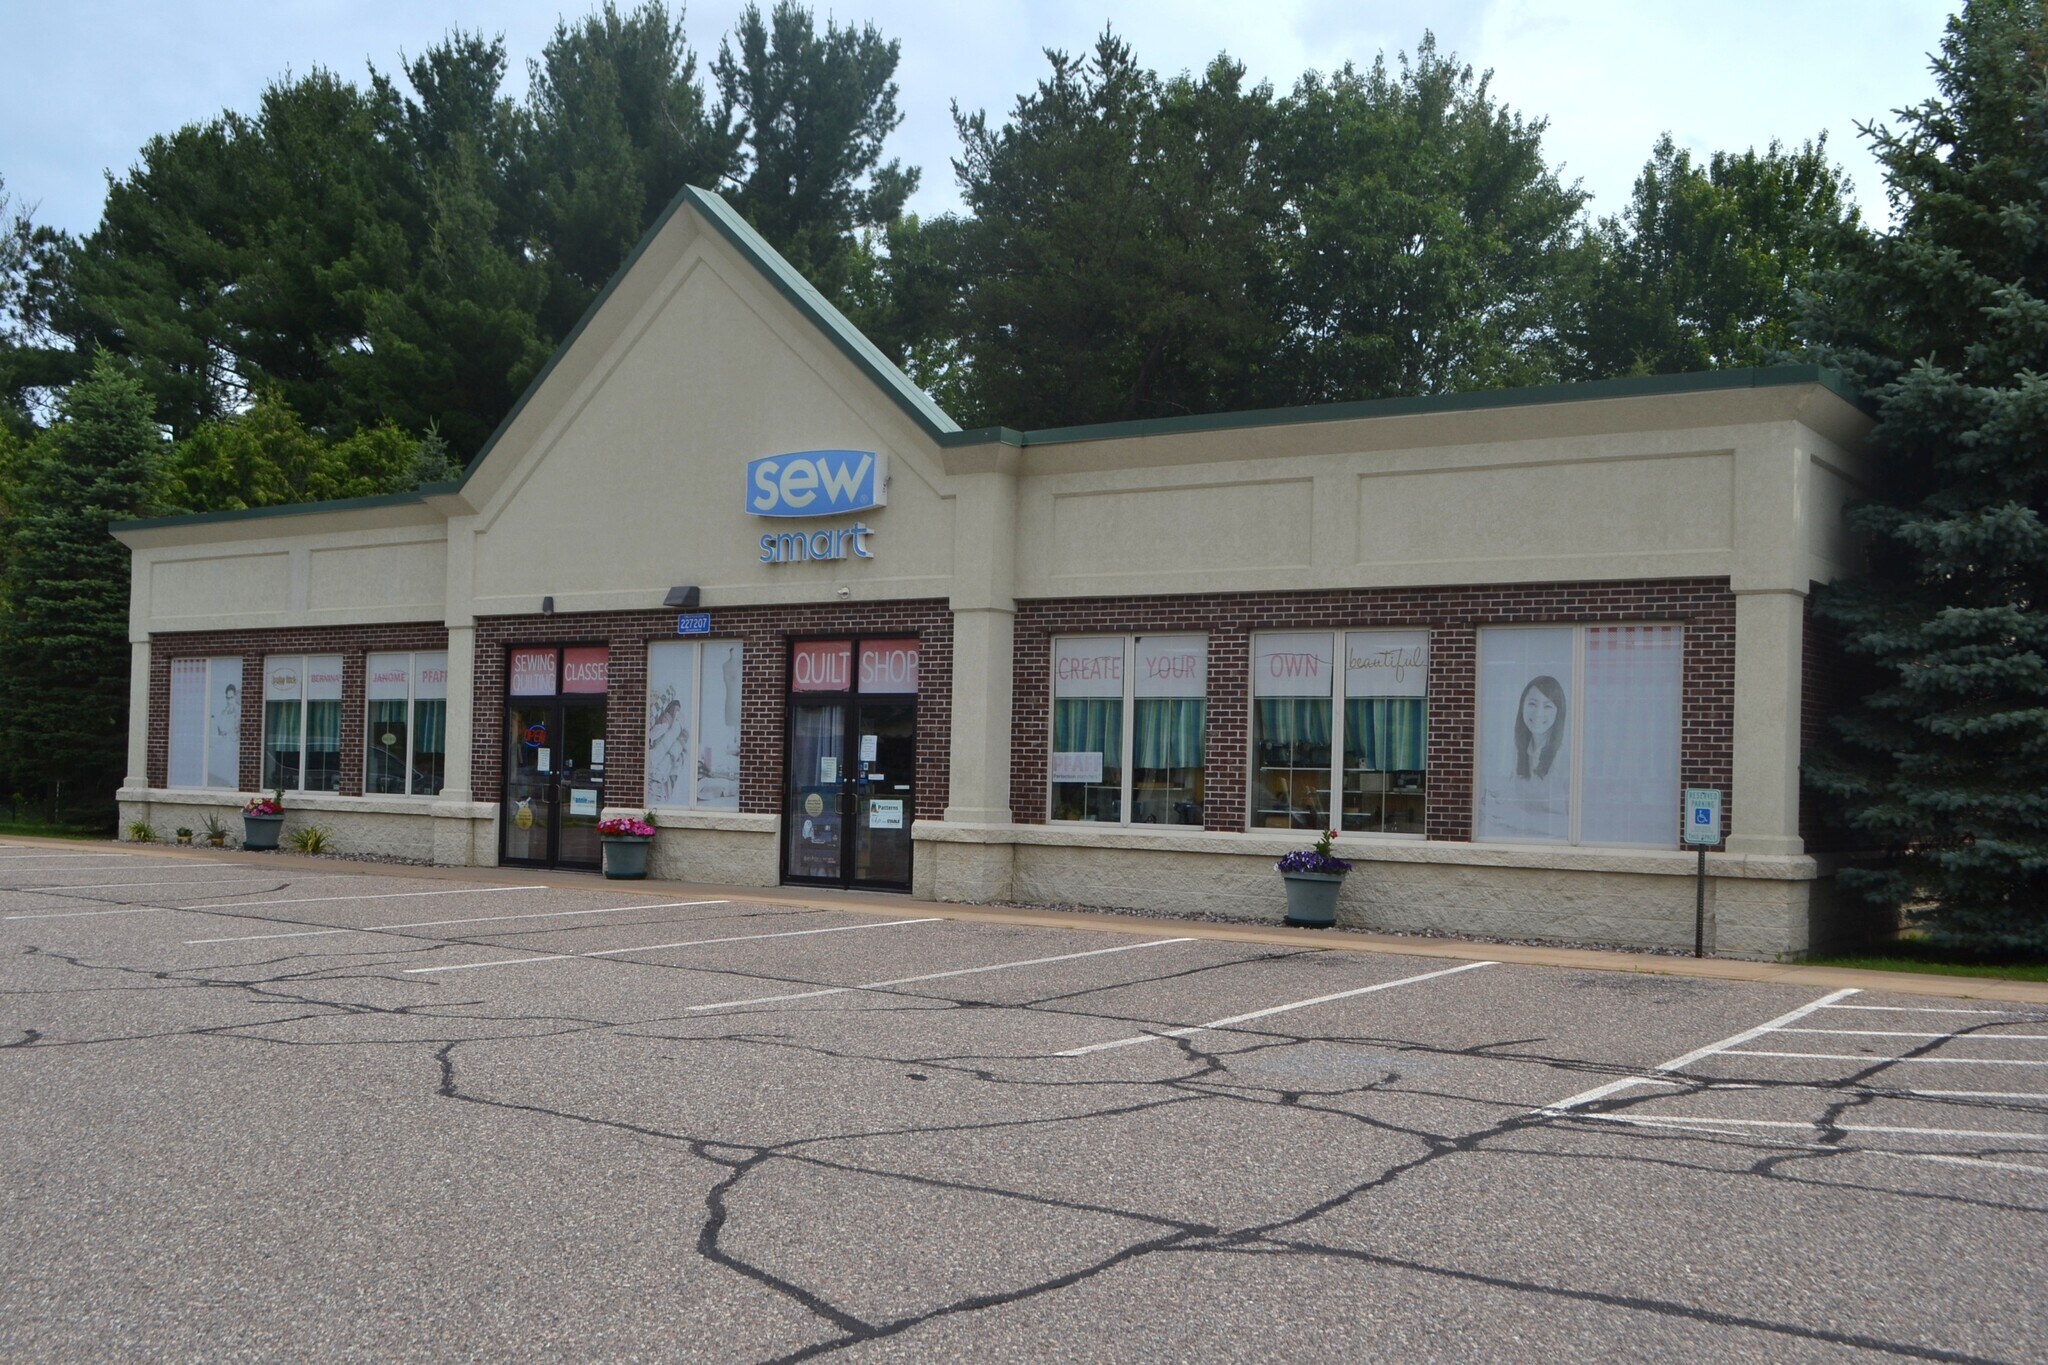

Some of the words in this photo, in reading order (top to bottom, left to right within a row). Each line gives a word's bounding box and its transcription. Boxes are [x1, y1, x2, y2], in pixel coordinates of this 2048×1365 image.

[753, 454, 873, 511] sew
[759, 522, 871, 563] smart
[680, 617, 708, 629] 227207
[514, 653, 555, 672] SEWING
[795, 651, 850, 684] QUILT
[861, 650, 919, 683] SHOP
[1058, 656, 1121, 680] CREATE
[1145, 654, 1197, 679] YOUR
[1270, 653, 1318, 678] OWN
[1349, 647, 1424, 683] beautiful
[373, 672, 406, 683] JANOME
[513, 674, 555, 691] QUILTING
